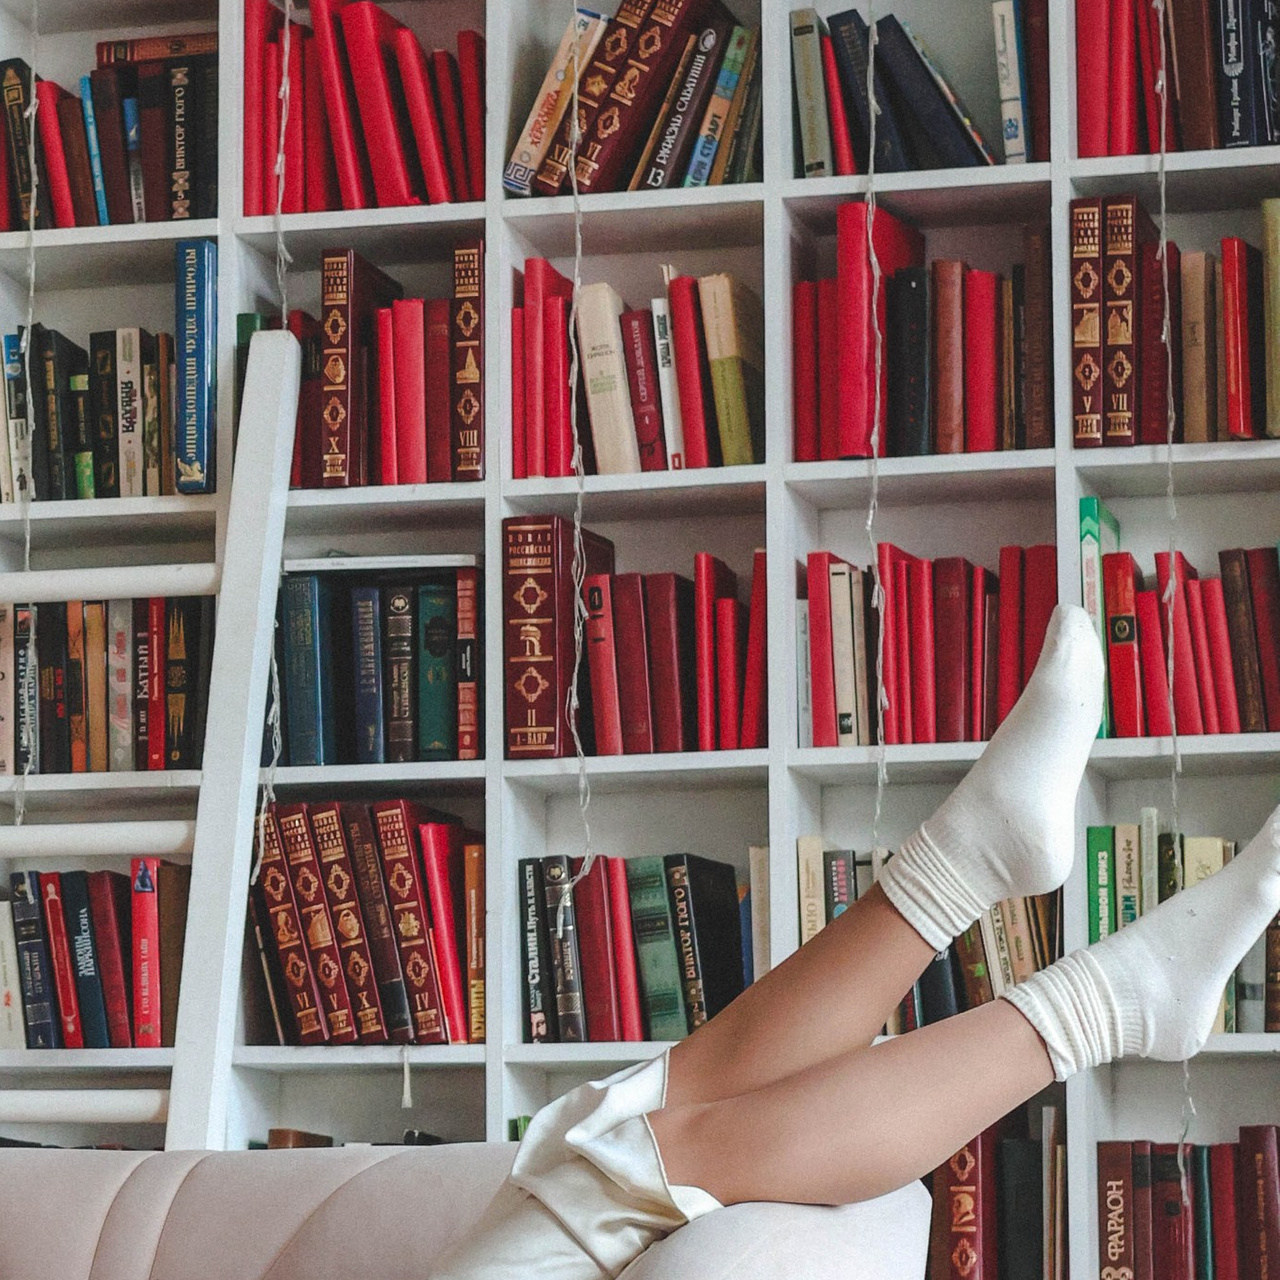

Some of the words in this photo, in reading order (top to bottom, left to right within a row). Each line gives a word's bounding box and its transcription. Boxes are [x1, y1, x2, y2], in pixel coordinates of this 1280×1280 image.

[174, 87, 184, 120] ГЮГО
[656, 113, 683, 164] РАФАЭЛЬ
[675, 53, 706, 112] САБАТИНИ
[173, 125, 185, 168] ВИКТОР
[646, 166, 665, 188] 13
[184, 248, 197, 309] ПРИРОДЫ
[185, 314, 197, 352] ЧУДЕС
[184, 357, 197, 459] ЭНЦИКЛОПЕДИЯ
[1083, 396, 1092, 412] V
[1112, 394, 1127, 410] VII
[329, 437, 339, 453] X
[460, 430, 478, 447] VIII
[509, 533, 551, 543] НОВАЯ
[509, 545, 551, 554] РОССИЙСКАЯ
[524, 864, 534, 896] власти
[1097, 851, 1107, 884] ПРИЗ
[673, 887, 689, 925] ГЮГО
[1097, 887, 1108, 939] ОЛЬШОЙ
[1122, 895, 1136, 923] ШИН
[74, 935, 87, 976] ЗАКОНЫ
[77, 907, 95, 976] ПАРКИНСОНА
[679, 928, 696, 978] ВИКТОР
[296, 994, 309, 1009] VI
[329, 993, 338, 1010] V
[358, 992, 370, 1010] X
[416, 992, 428, 1010] IV
[1105, 1180, 1124, 1260] ФАРАОН
